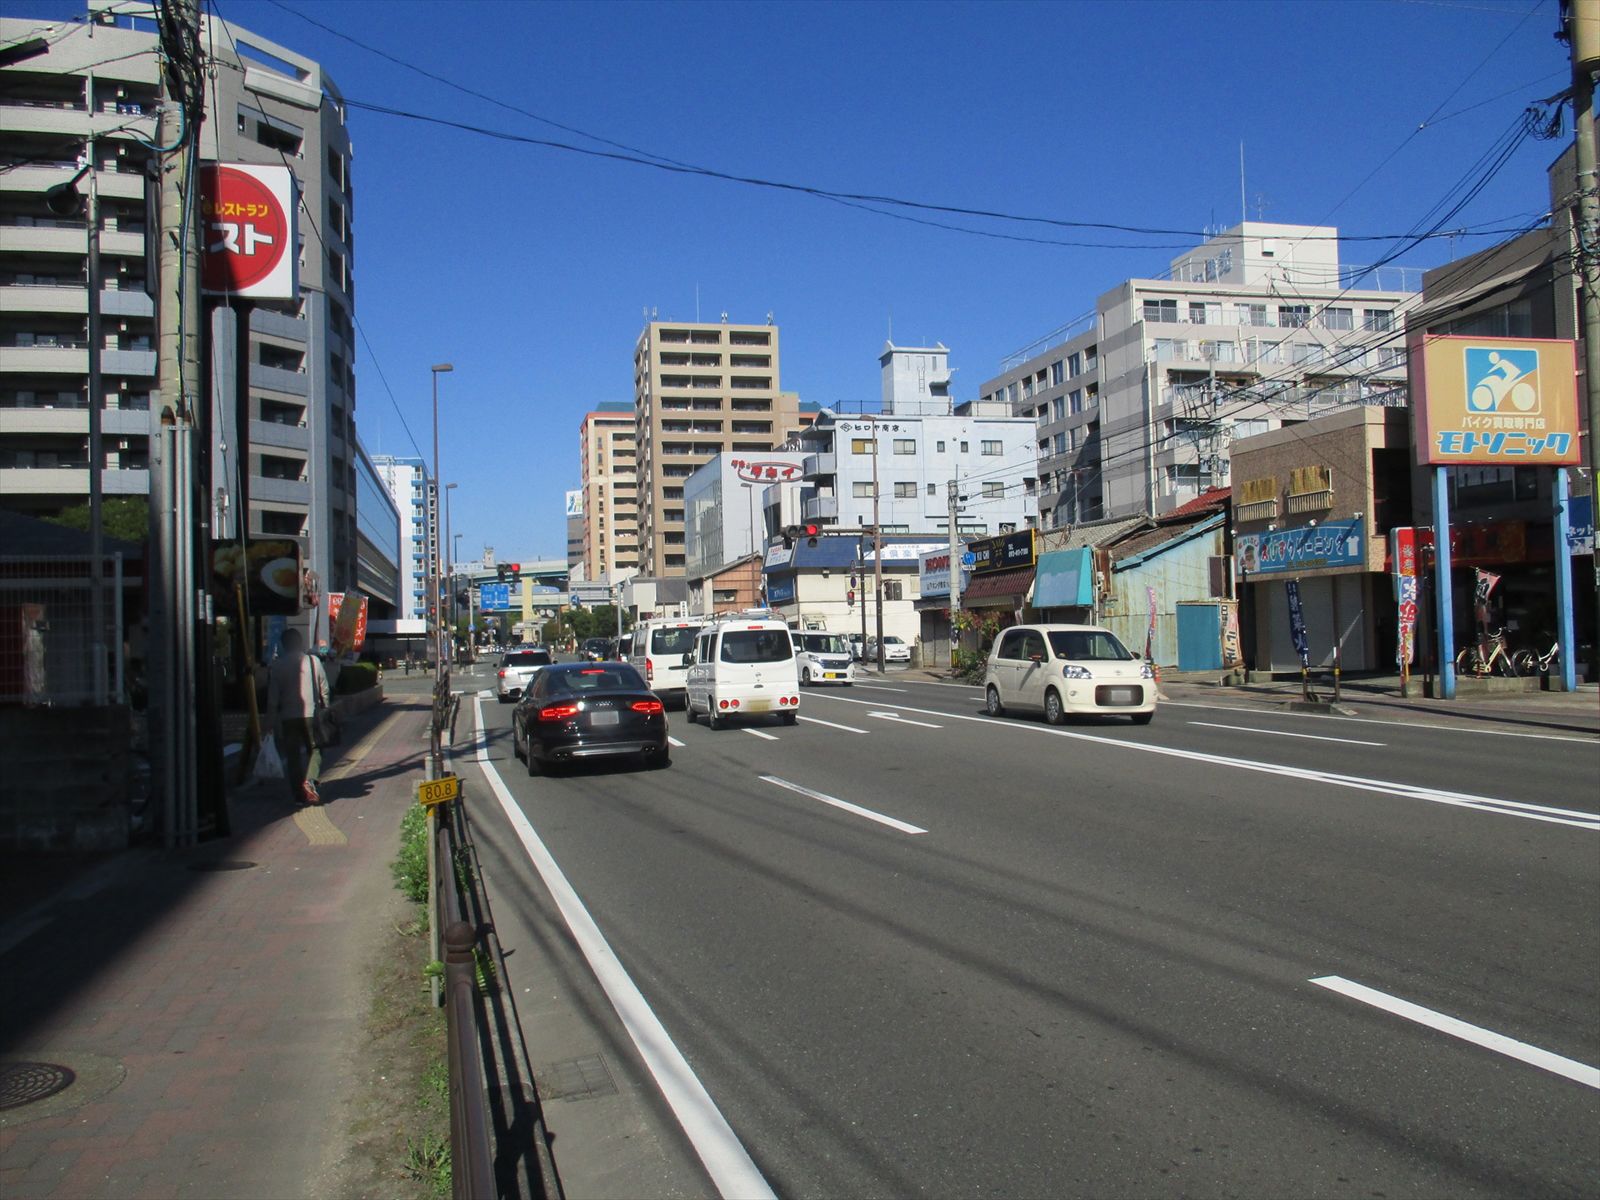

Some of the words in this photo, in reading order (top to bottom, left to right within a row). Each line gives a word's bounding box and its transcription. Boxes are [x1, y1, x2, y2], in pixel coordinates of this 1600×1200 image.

[1462, 416, 1546, 430] バイク買取専門店
[1435, 431, 1571, 455] モトソニック
[425, 783, 452, 800] 80.8
